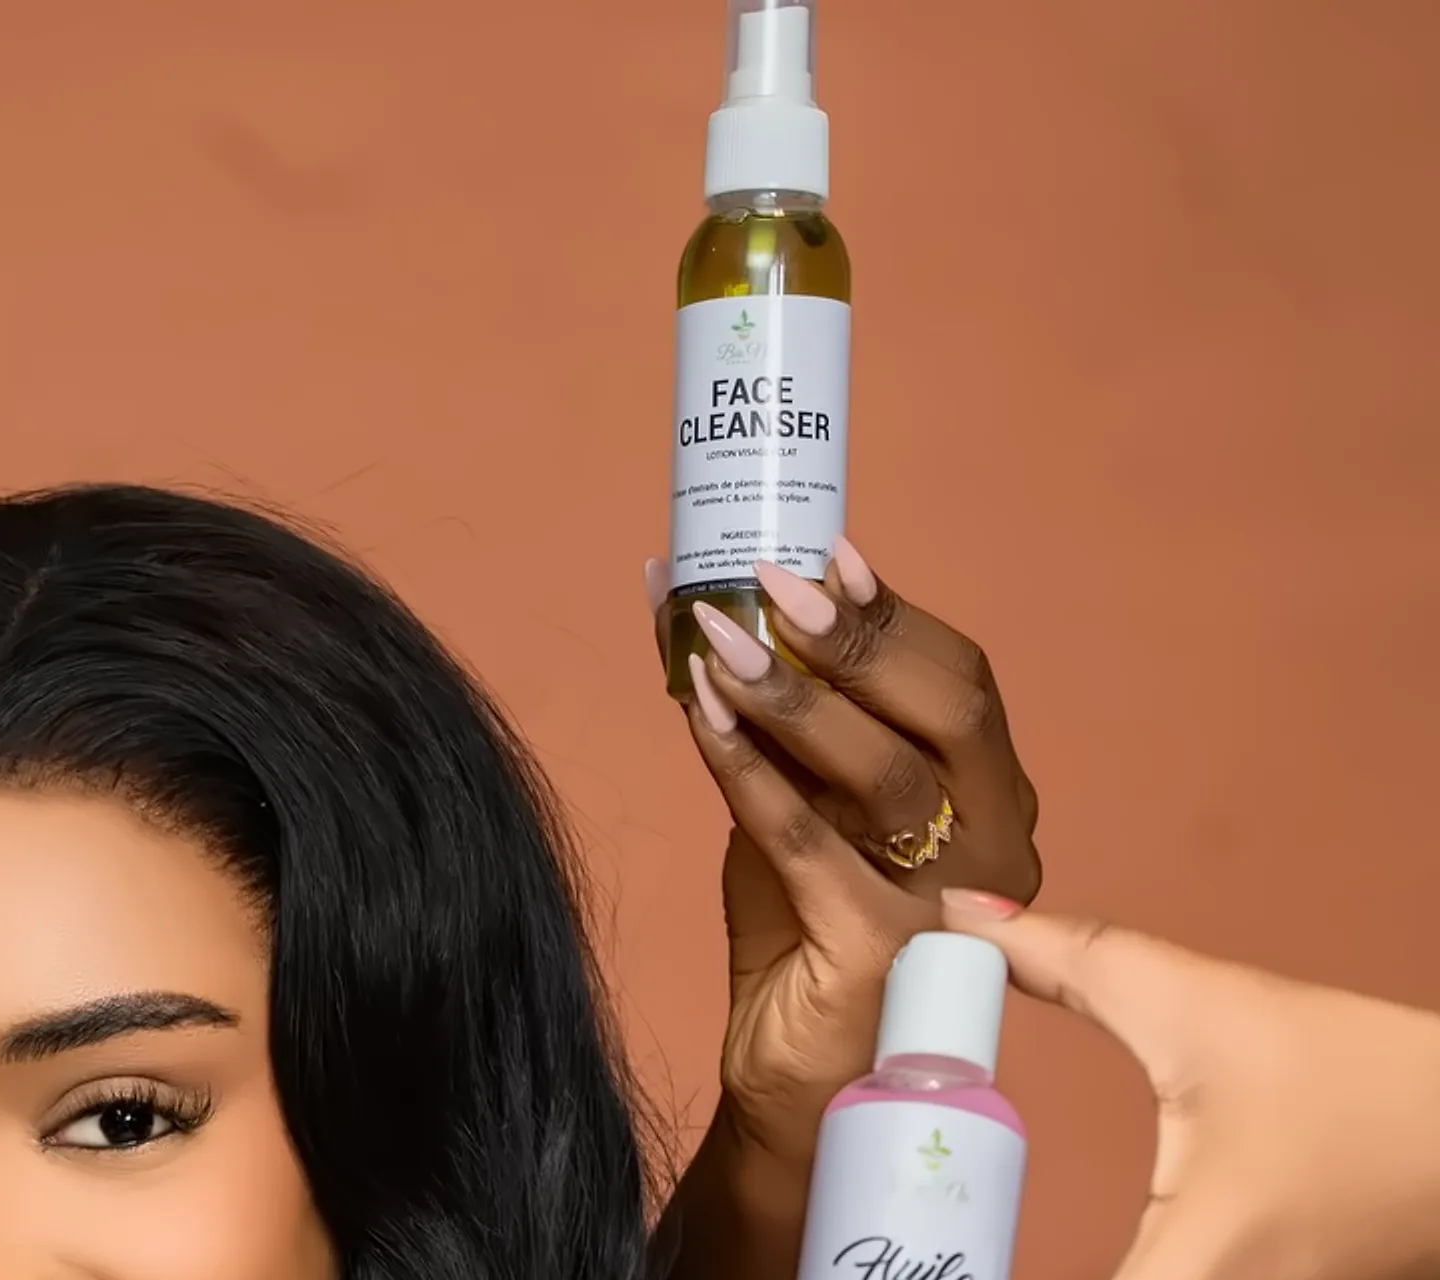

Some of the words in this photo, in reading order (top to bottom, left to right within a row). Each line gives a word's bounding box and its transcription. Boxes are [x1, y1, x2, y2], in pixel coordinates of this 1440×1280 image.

[711, 376, 795, 407] FACE
[679, 410, 831, 447] CLEANSER
[777, 480, 806, 489] oudres
